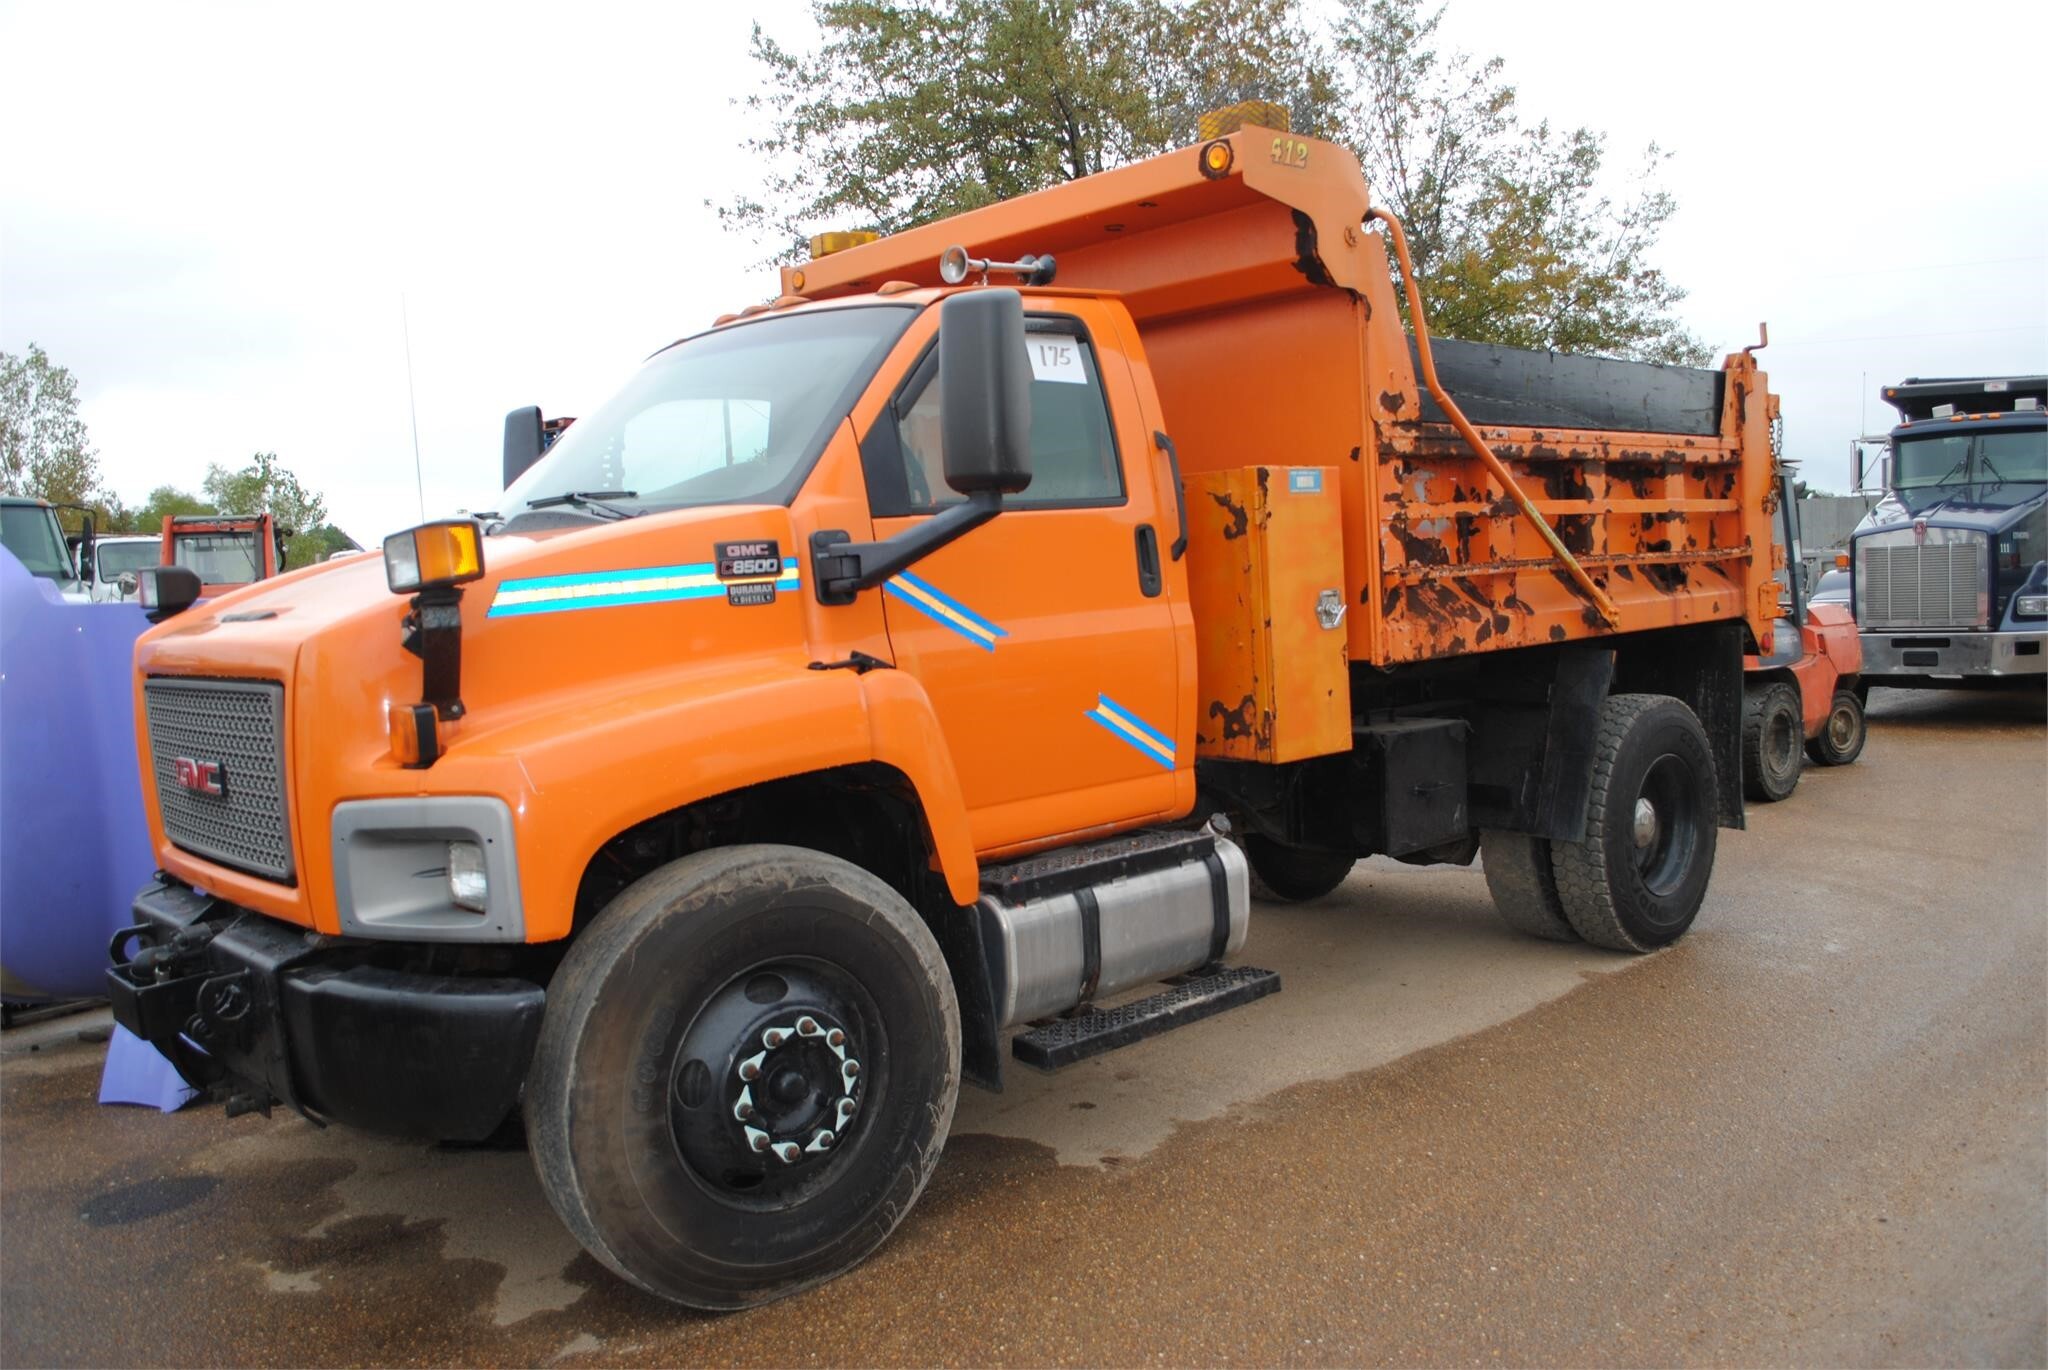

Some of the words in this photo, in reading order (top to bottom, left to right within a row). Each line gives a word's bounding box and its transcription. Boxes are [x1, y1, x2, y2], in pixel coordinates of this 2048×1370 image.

[1271, 137, 1309, 169] 412
[1040, 344, 1072, 367] 175
[726, 543, 769, 557] GMC
[720, 558, 778, 576] C8500
[730, 583, 773, 595] DURAMAX
[175, 757, 222, 795] GMC
